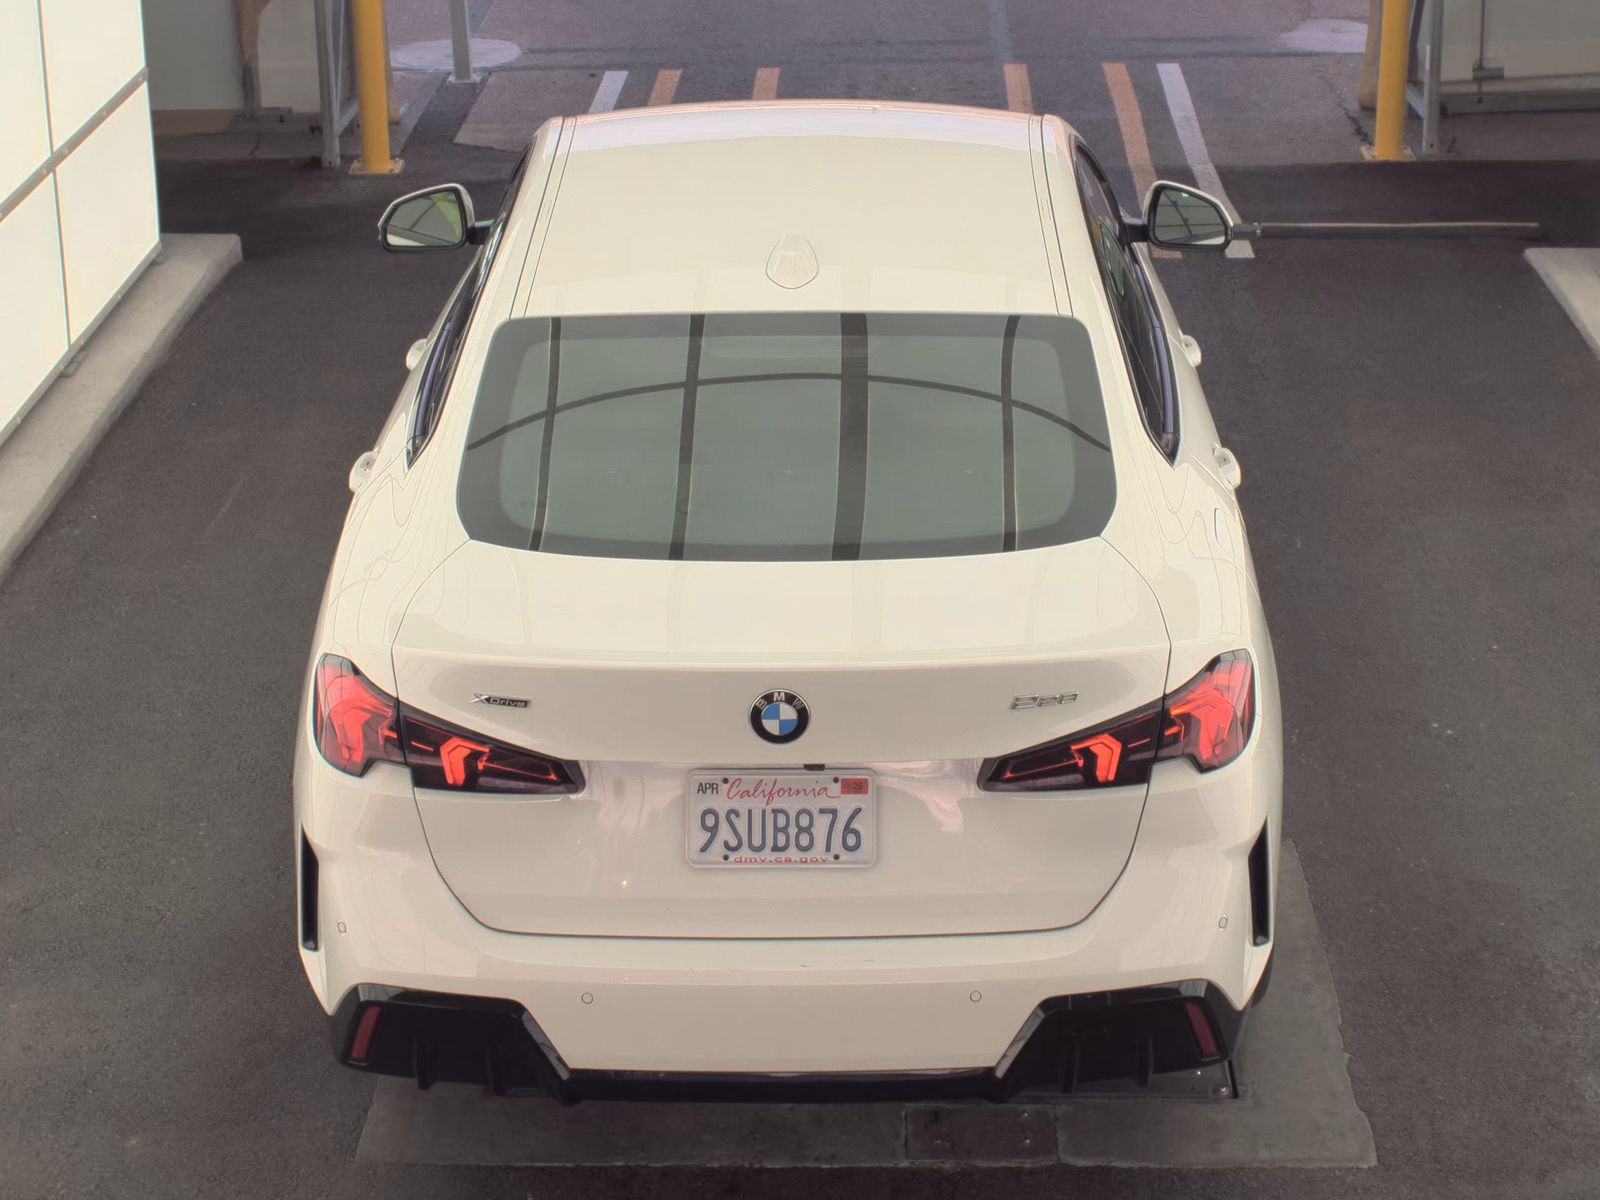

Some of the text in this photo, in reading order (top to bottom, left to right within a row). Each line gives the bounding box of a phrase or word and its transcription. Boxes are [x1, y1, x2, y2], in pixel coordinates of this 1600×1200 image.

[755, 691, 805, 711] BMW
[697, 782, 719, 795] APR
[726, 777, 842, 806] California
[699, 807, 862, 853] 9SUB876
[734, 855, 828, 864] dmv.ca.gov
